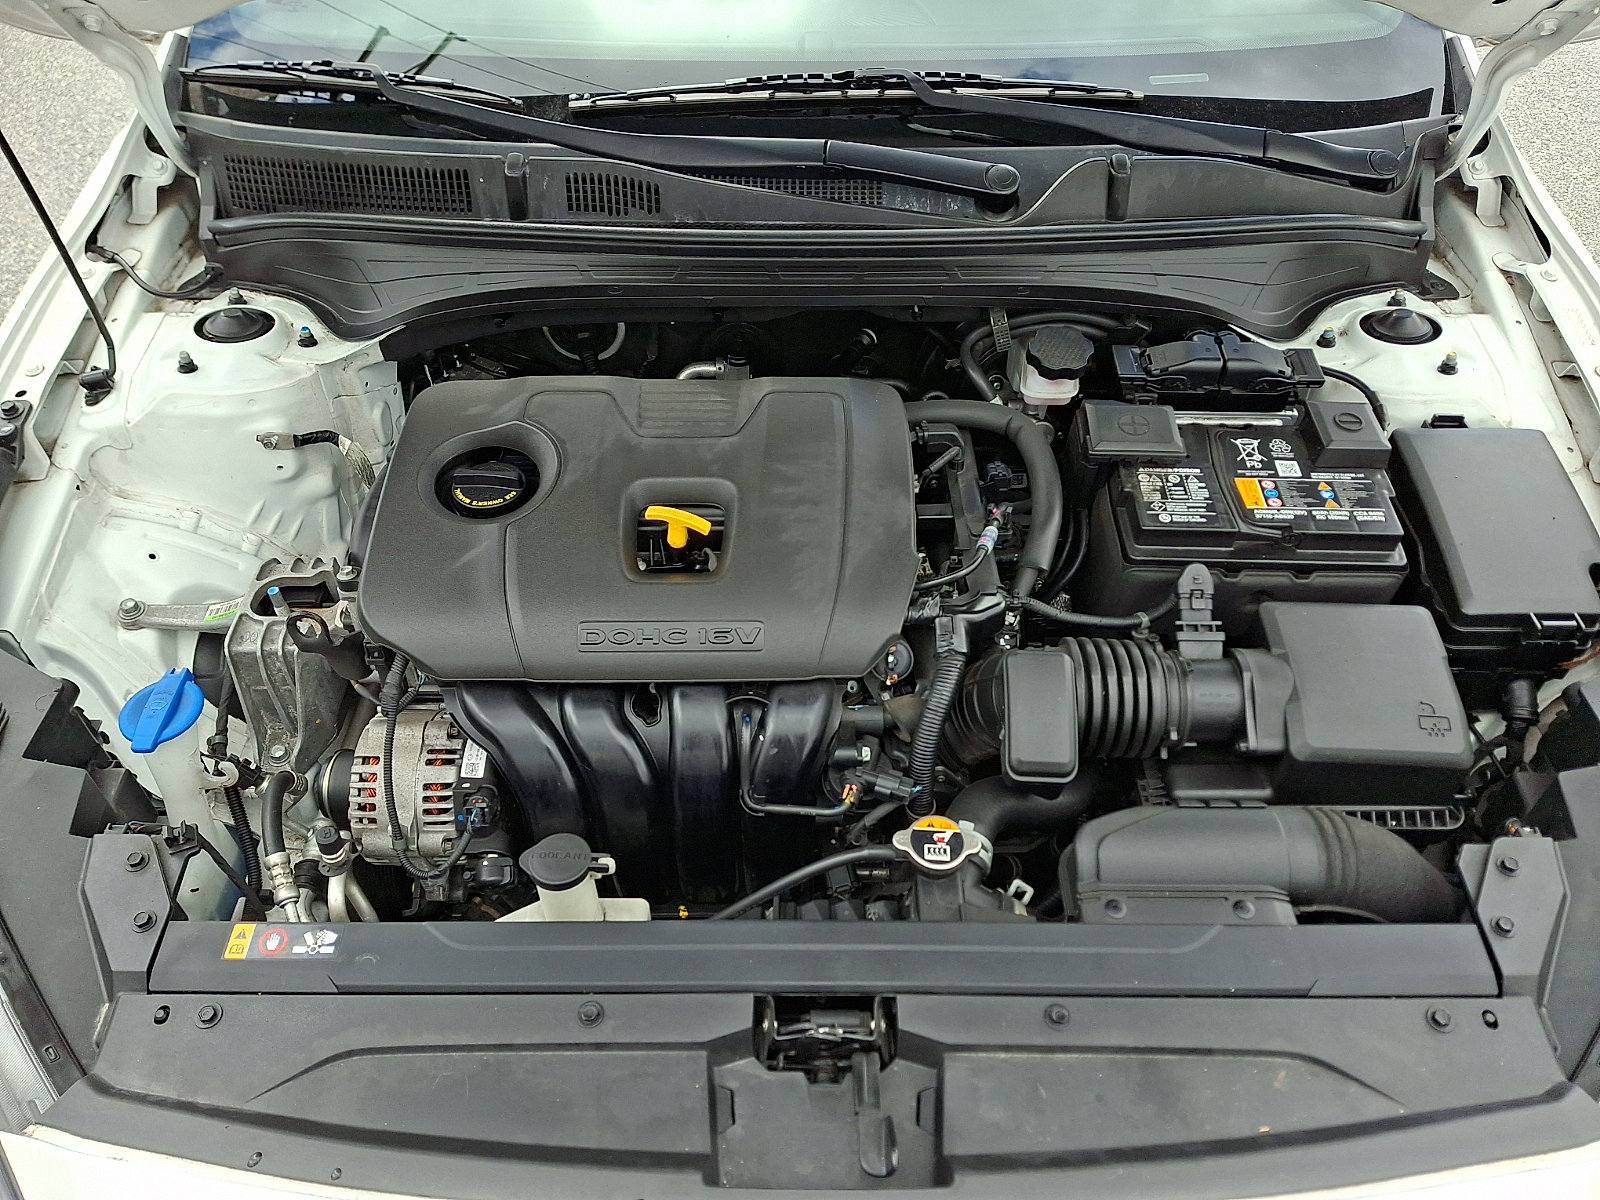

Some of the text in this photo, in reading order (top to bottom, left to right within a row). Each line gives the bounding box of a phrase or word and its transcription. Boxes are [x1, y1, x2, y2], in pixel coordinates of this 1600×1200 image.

[454, 488, 517, 506] SEE OWNER'S MANUAL
[580, 627, 762, 645] DOHC 16V
[531, 851, 591, 861] COOLANT
